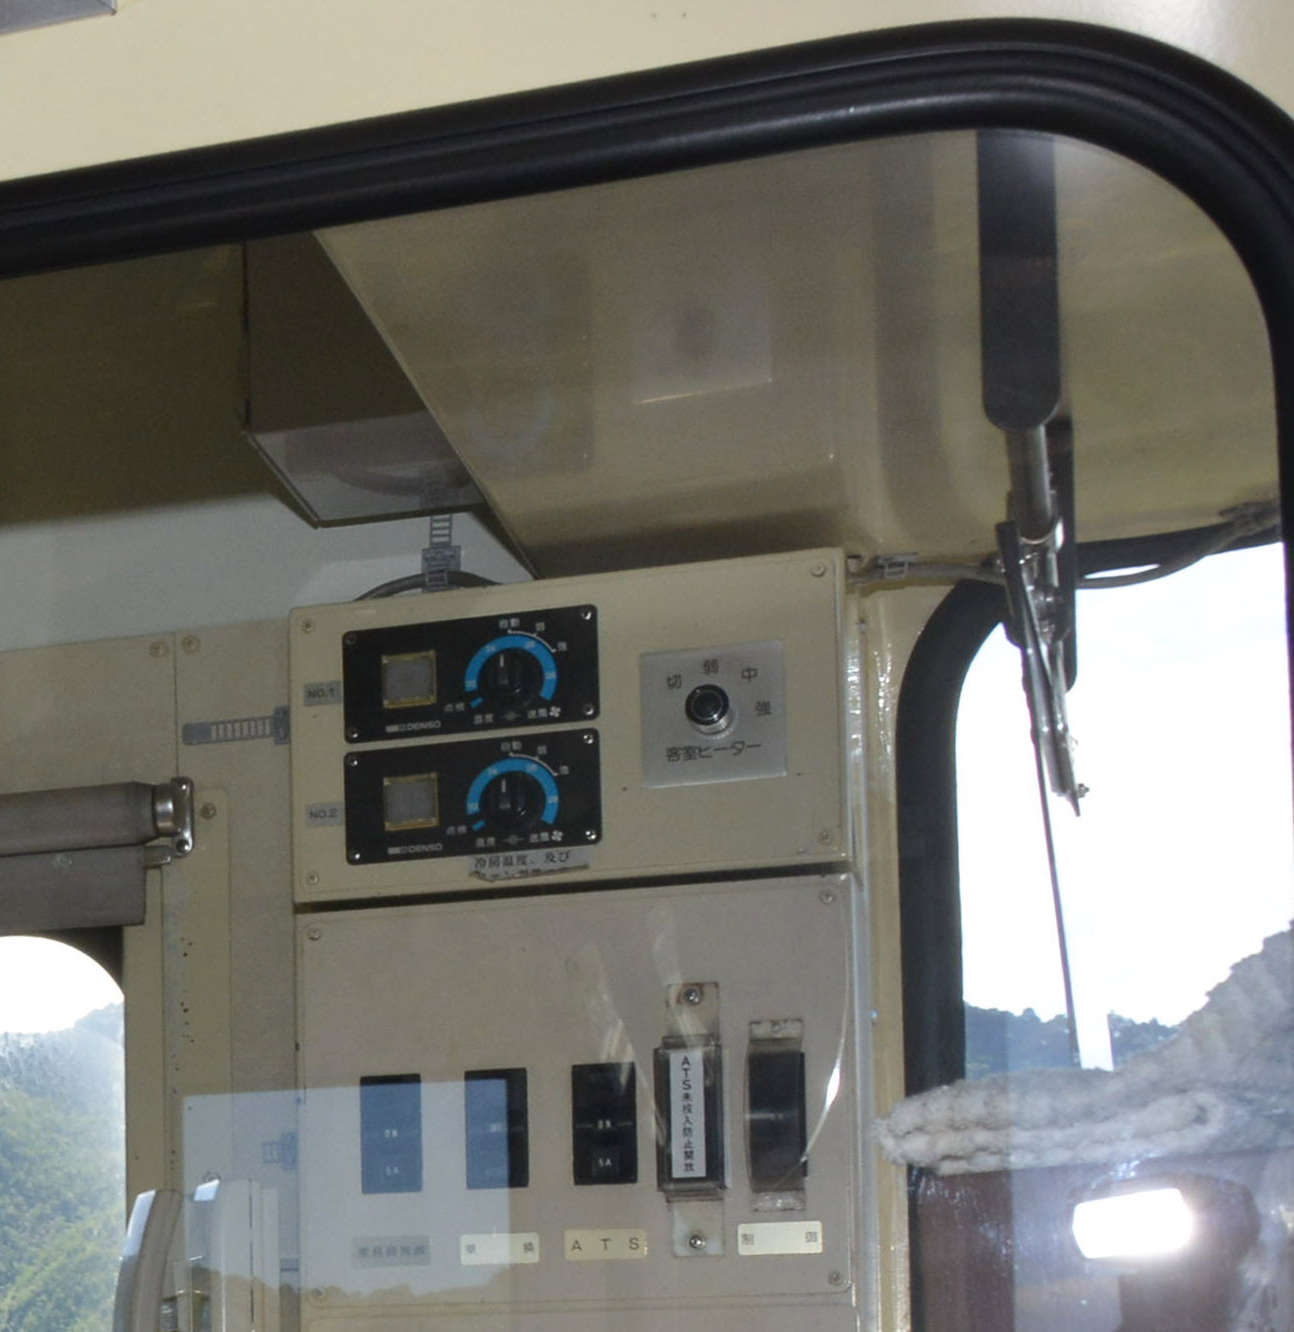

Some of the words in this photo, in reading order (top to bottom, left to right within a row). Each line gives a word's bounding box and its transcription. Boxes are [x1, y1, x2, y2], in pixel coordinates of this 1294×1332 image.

[703, 658, 719, 675] 弱
[741, 667, 758, 682] 中
[666, 674, 682, 690] 切
[756, 701, 772, 717] 強
[665, 740, 763, 763] 客室ヒーター
[309, 808, 339, 820] NO.2
